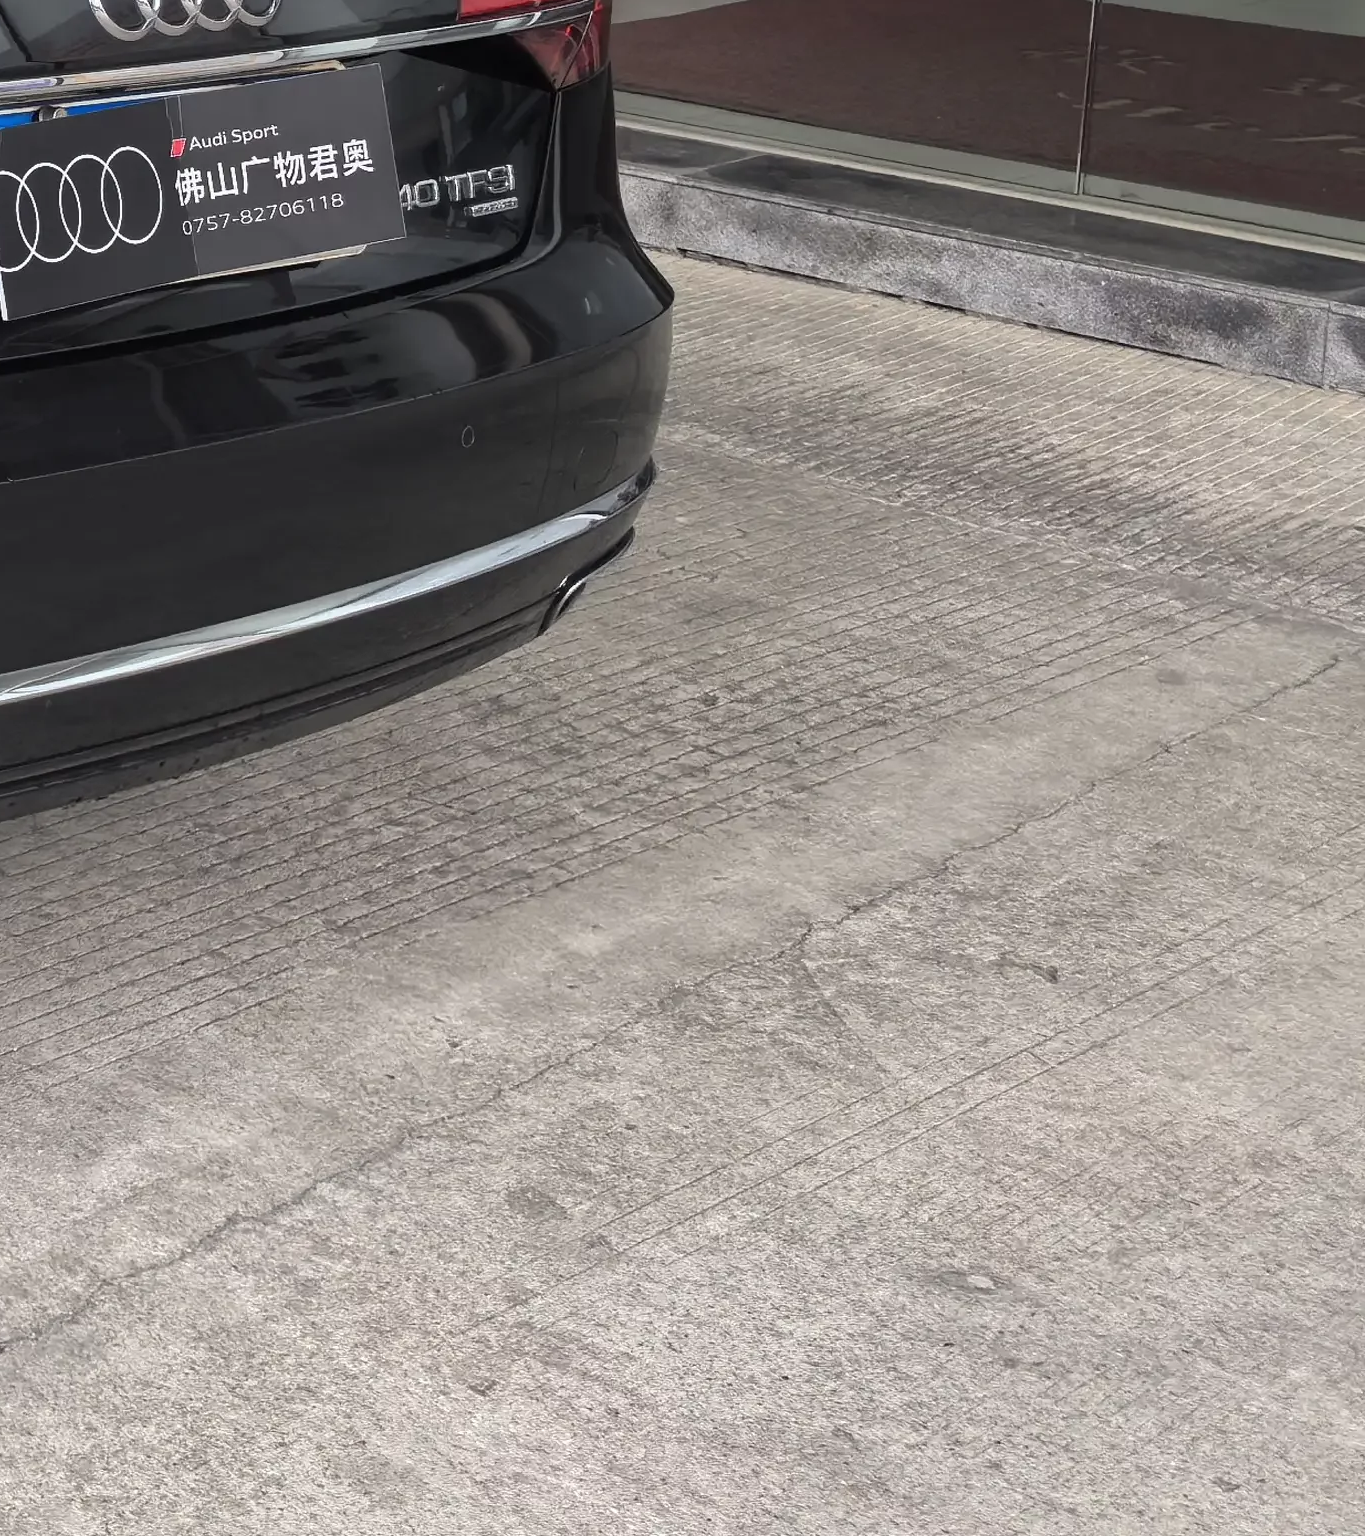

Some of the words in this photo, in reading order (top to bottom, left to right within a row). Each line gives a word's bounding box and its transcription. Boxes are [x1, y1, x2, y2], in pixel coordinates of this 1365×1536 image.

[189, 131, 227, 152] Audi
[231, 124, 279, 146] Sport
[175, 138, 375, 207] 佛山广物君奥
[443, 164, 516, 202] TFSI
[182, 193, 345, 236] 0757-82706118
